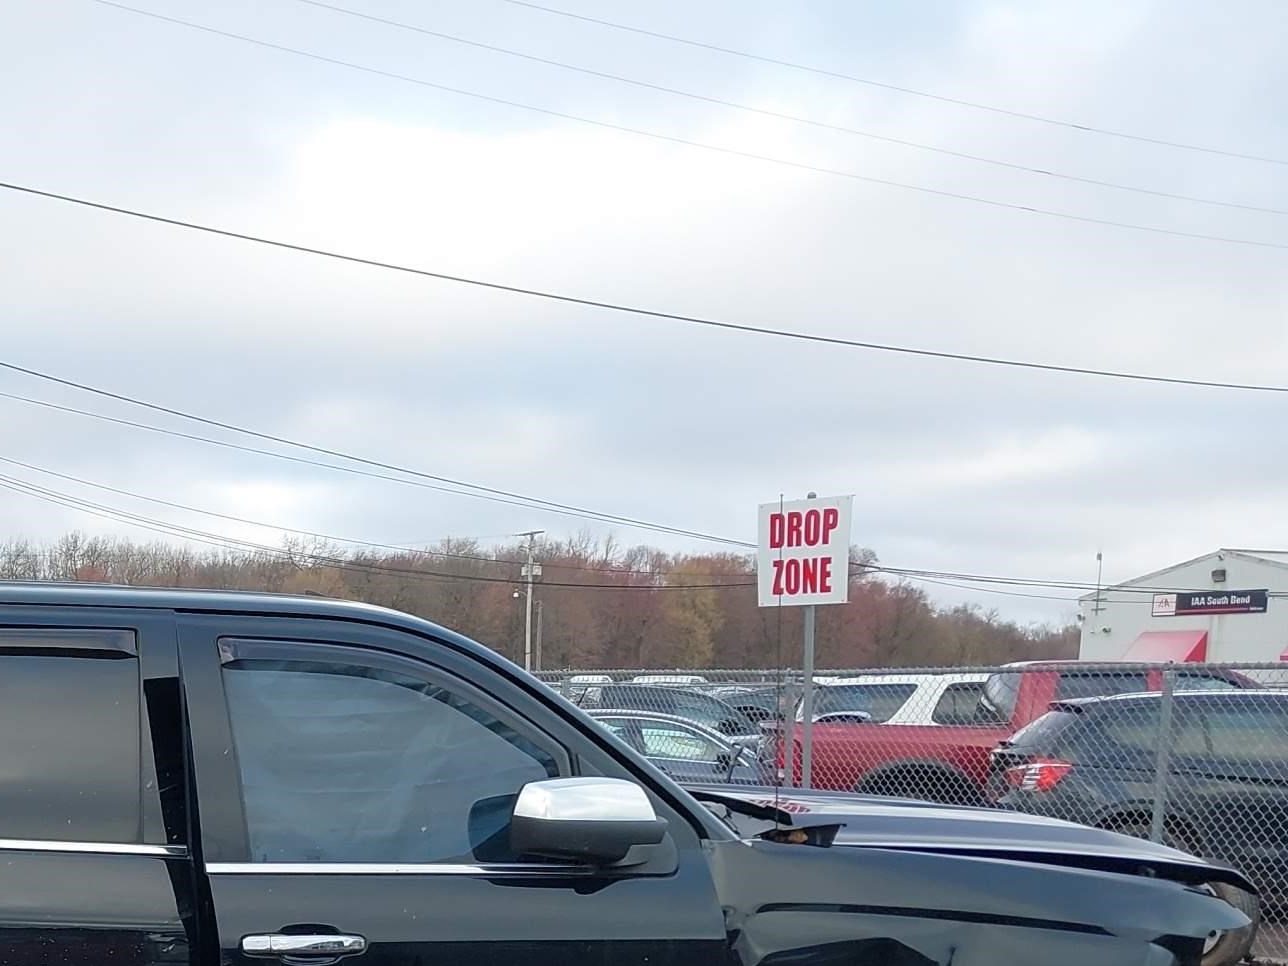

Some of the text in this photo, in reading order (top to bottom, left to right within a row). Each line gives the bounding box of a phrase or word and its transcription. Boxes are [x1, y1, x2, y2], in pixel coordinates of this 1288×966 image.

[769, 508, 839, 549] DROP
[772, 557, 832, 596] ZONE
[1191, 595, 1251, 606] IAA South Bend
